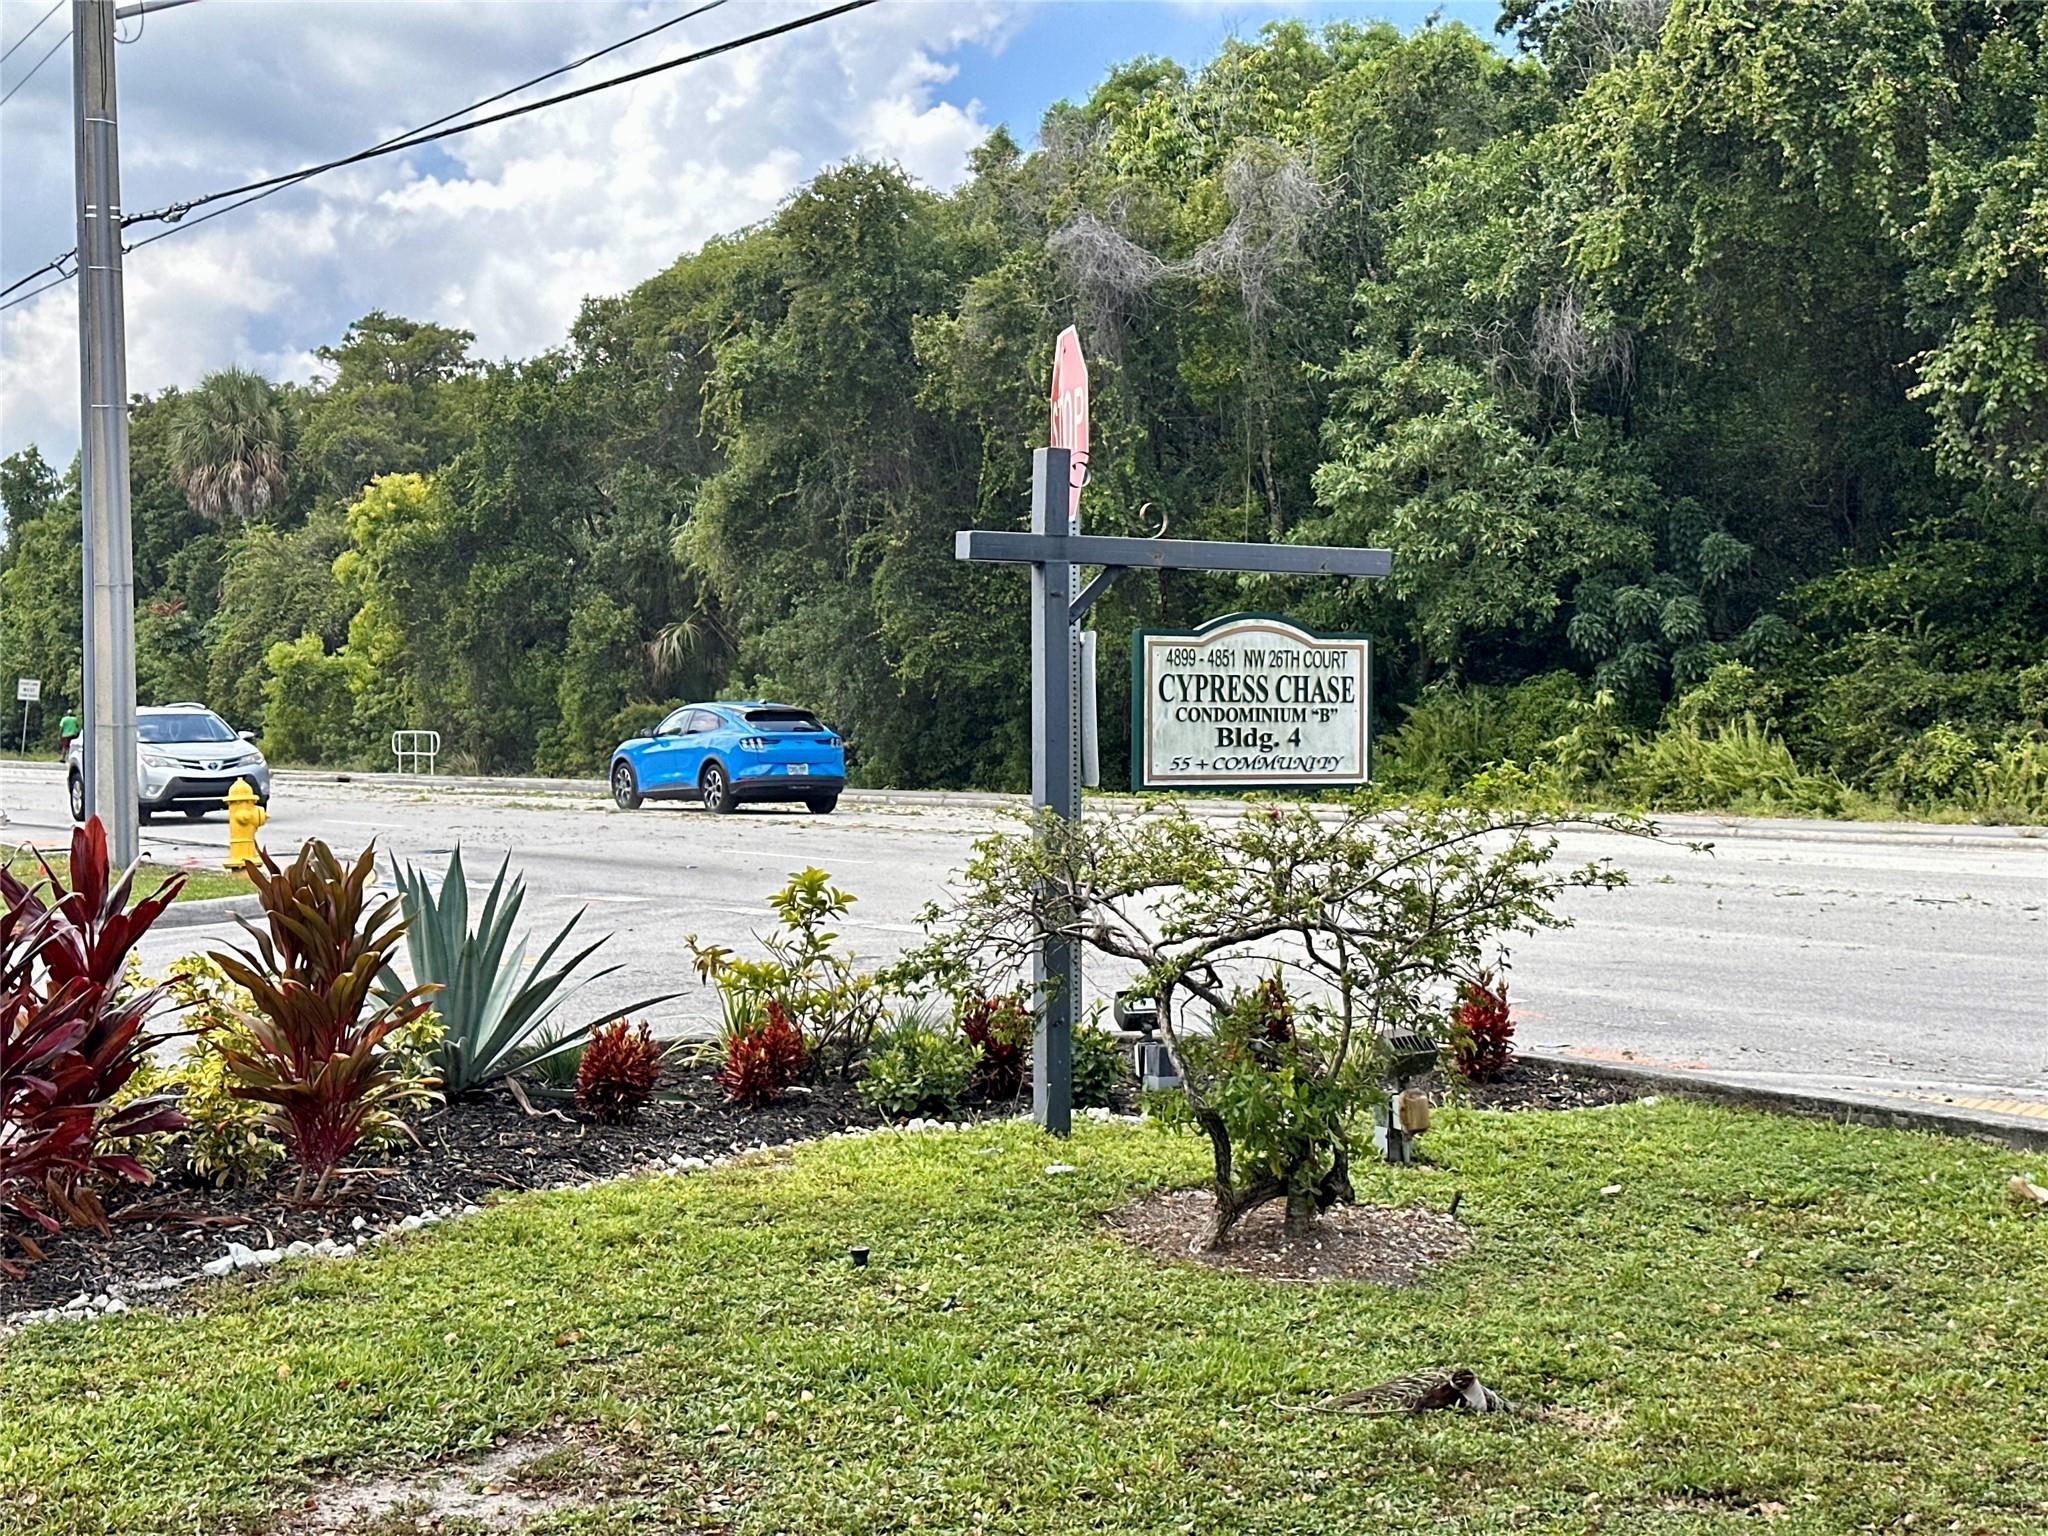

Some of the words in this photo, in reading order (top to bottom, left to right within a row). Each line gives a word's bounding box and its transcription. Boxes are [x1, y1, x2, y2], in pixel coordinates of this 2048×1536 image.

[1052, 386, 1085, 448] STOP
[1166, 648, 1196, 667] 4899
[1207, 649, 1236, 667] 4851
[1244, 650, 1266, 668] NW
[1268, 650, 1300, 668] 26TH
[1303, 650, 1348, 669] COURT
[1158, 673, 1269, 703] CYPRESS
[1275, 674, 1355, 704] CHASE
[1175, 706, 1307, 723] CONDOMINIUM
[1215, 727, 1280, 752] Bldg.
[1287, 727, 1301, 747] 4
[1169, 756, 1192, 771] 55
[1195, 758, 1210, 770] +
[1212, 755, 1344, 772] COMMUNITY
